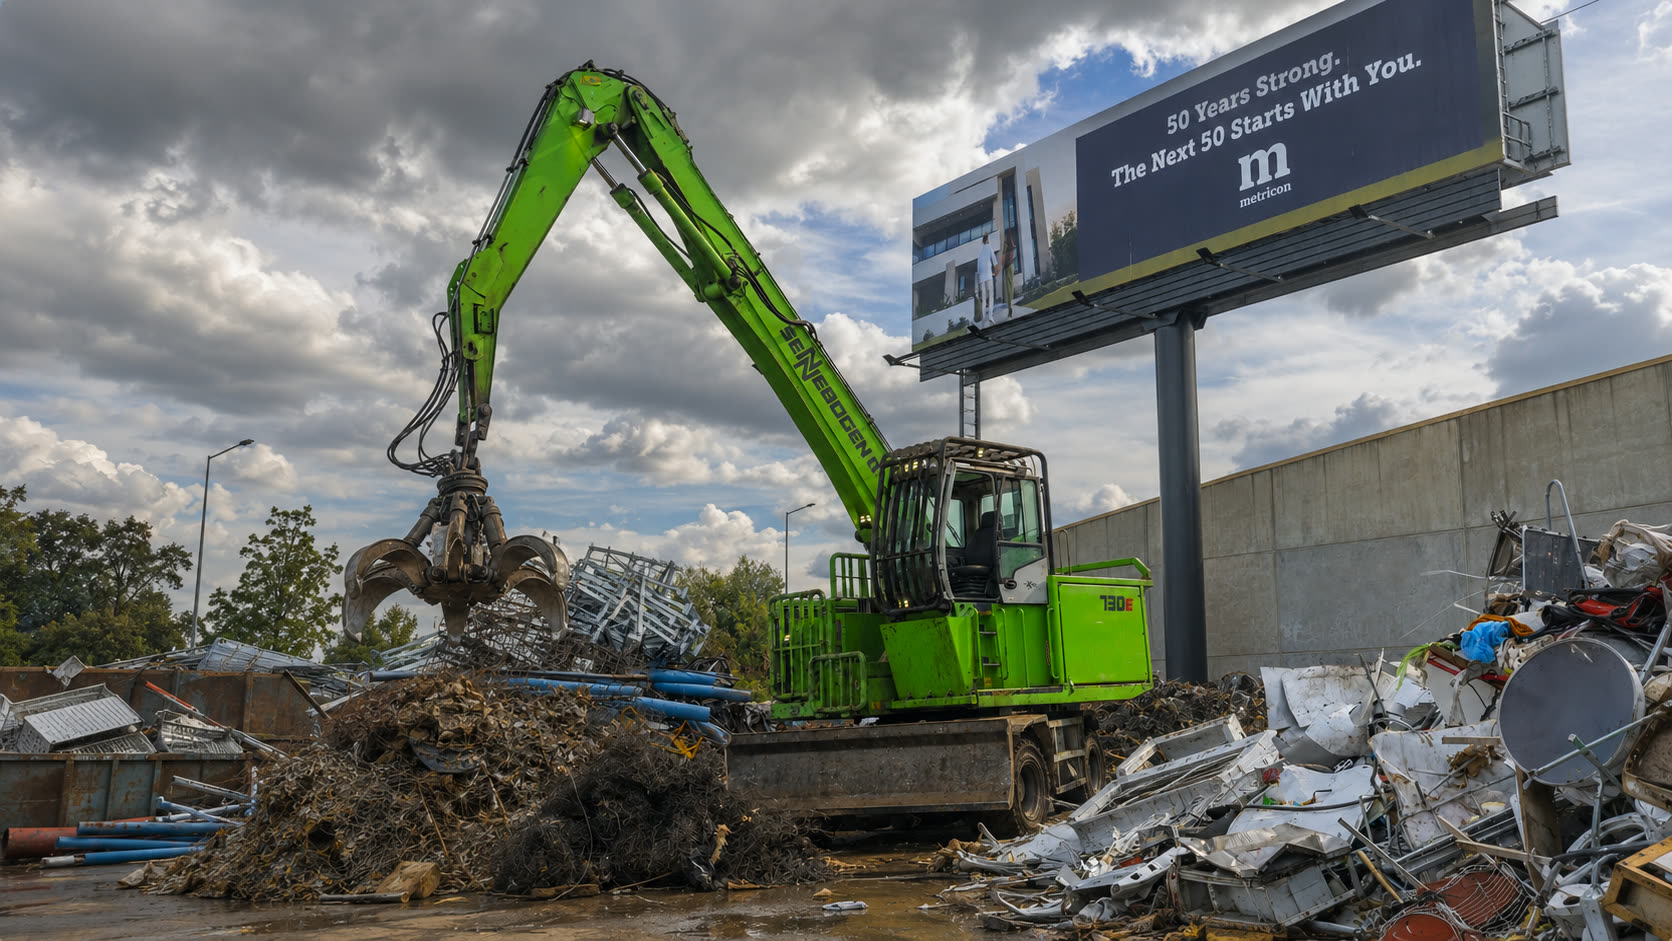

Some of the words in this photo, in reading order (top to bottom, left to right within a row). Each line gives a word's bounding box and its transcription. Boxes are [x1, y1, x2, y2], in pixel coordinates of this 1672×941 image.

[1111, 162, 1147, 188] The
[1151, 138, 1196, 173] Next
[1200, 125, 1225, 152] 50
[1230, 102, 1295, 140] Starts
[1299, 73, 1360, 112] With
[1364, 52, 1422, 86] You.
[1167, 109, 1190, 135] 50
[1194, 87, 1251, 123] Years
[1256, 51, 1341, 97] Strong.
[1237, 142, 1291, 192] m
[1239, 183, 1292, 209] metricon
